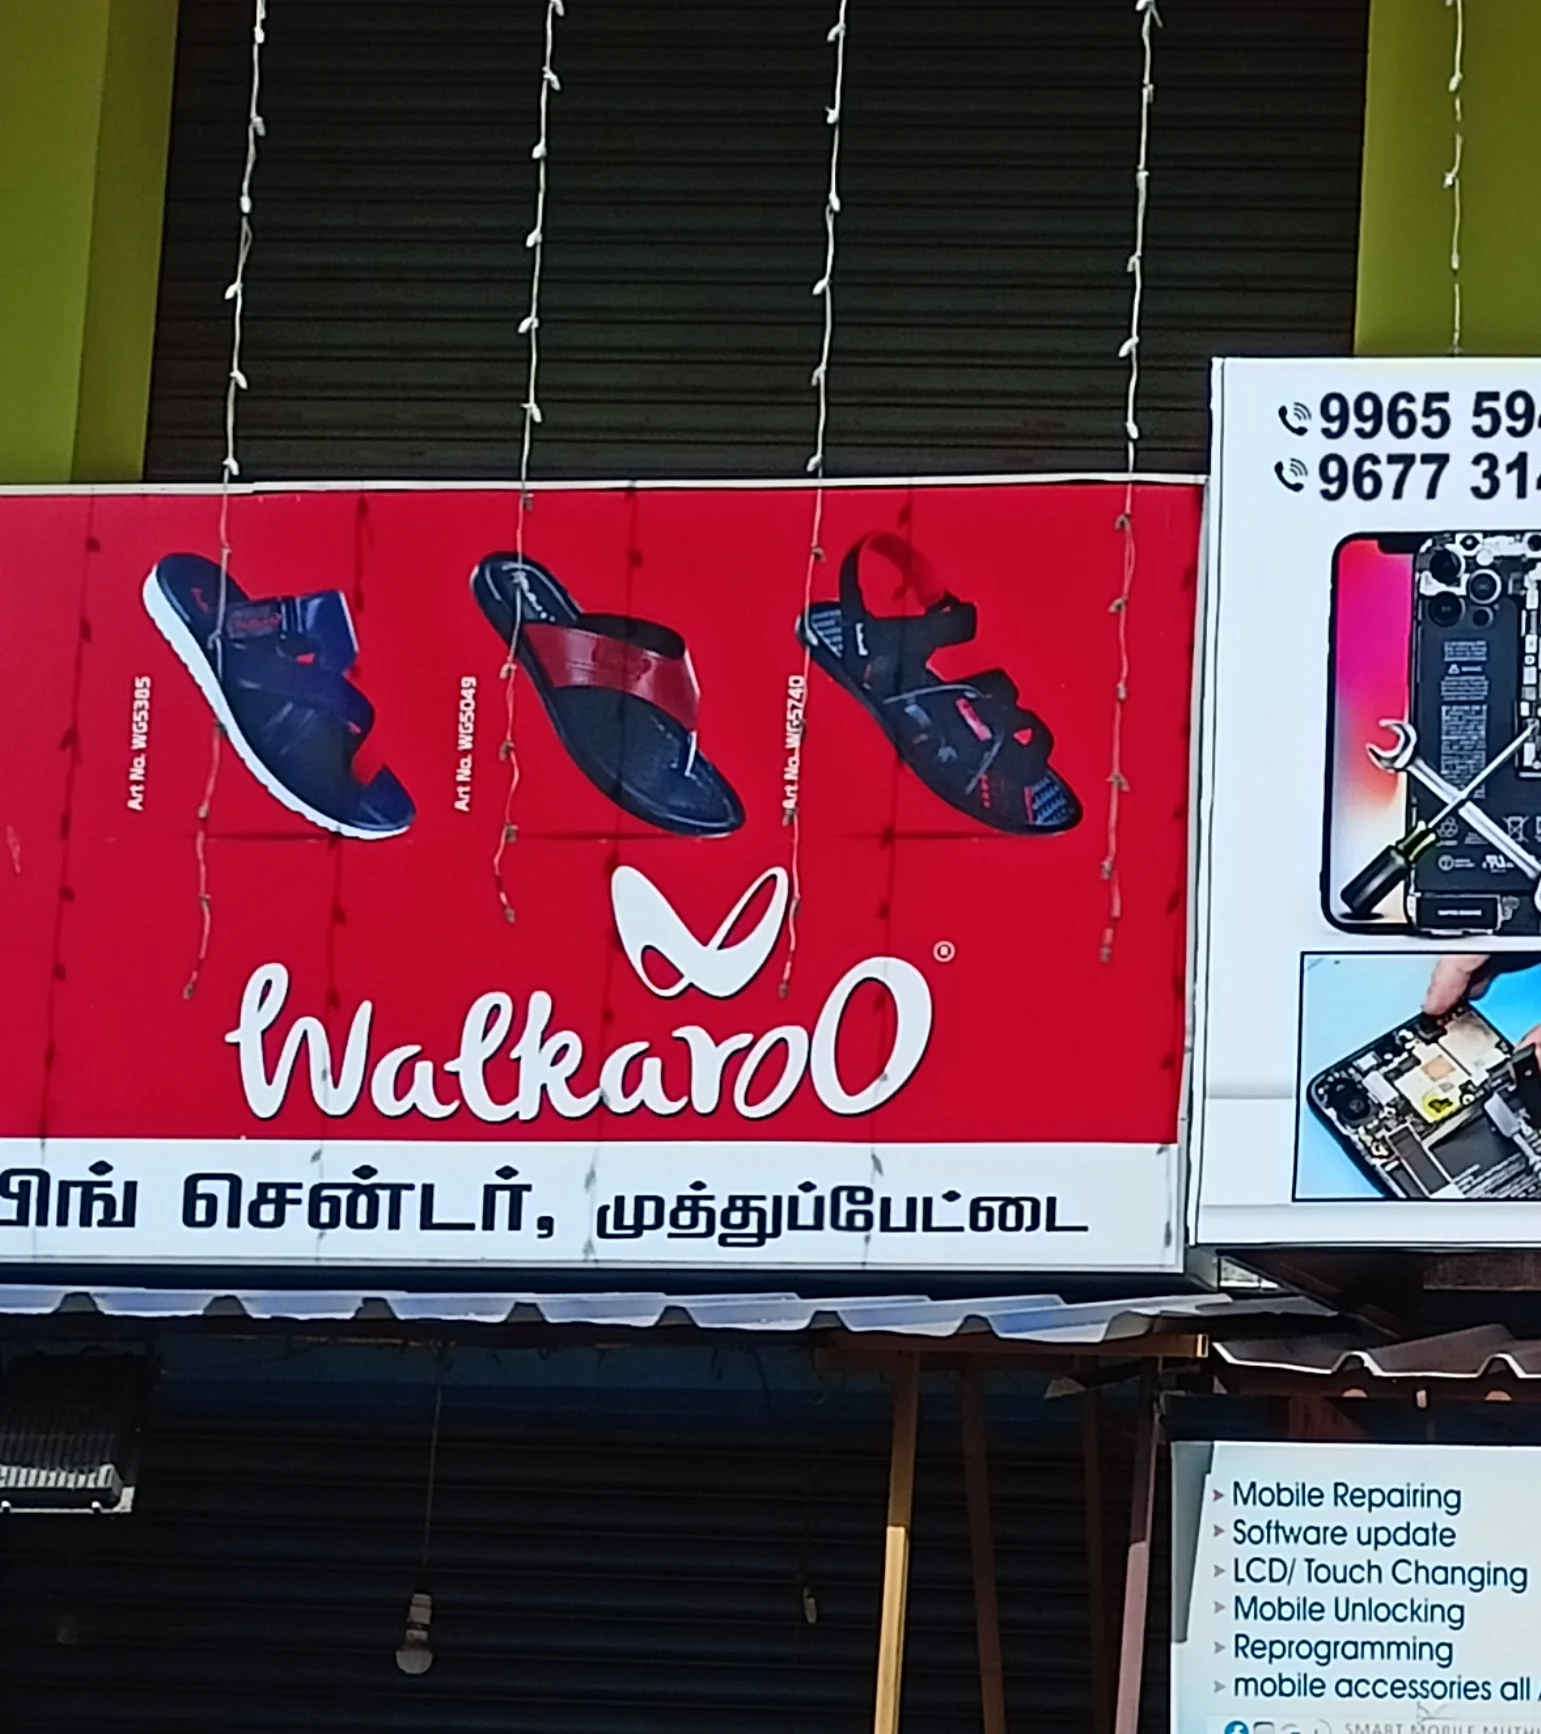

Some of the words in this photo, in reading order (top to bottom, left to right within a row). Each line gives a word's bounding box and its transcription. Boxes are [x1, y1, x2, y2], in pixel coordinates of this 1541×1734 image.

[1319, 390, 1451, 440] 9965
[1318, 452, 1450, 501] 9677
[1233, 1481, 1324, 1507] Mobile
[1333, 1482, 1462, 1515] Repairing
[1232, 1519, 1347, 1547] Software
[1357, 1522, 1456, 1550] update
[1233, 1557, 1296, 1586] LCD/
[1304, 1557, 1382, 1585] Touch
[1392, 1559, 1528, 1594] Changing
[1234, 1596, 1324, 1623] Mobile
[1334, 1598, 1465, 1630] Unlocking
[1234, 1634, 1453, 1668] Reprogramming
[1234, 1672, 1325, 1699] mobile
[1334, 1676, 1491, 1702] accessories
[1500, 1675, 1531, 1702] all
